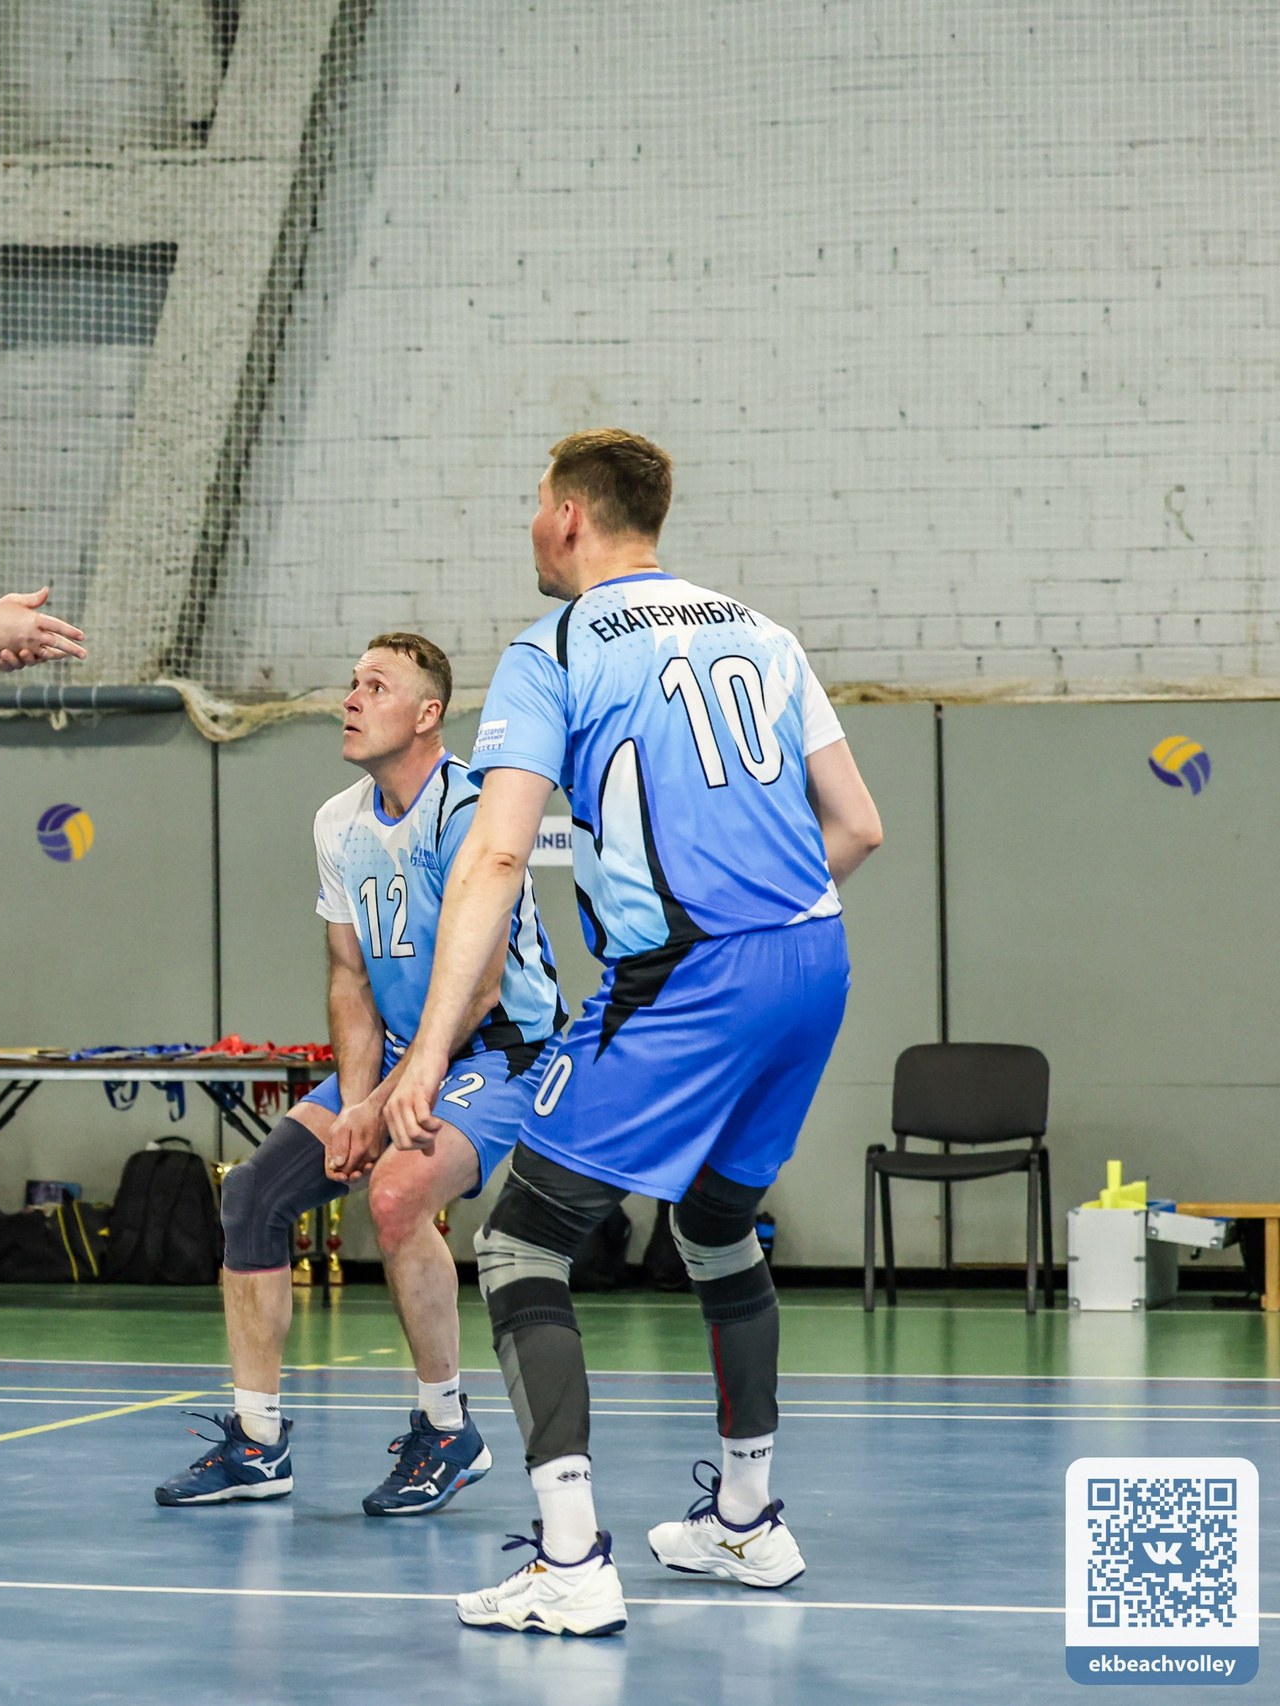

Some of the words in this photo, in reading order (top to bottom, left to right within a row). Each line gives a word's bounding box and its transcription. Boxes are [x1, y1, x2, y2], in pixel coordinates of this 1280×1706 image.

[588, 601, 758, 643] ЕКАТЕРИНБУРГ
[658, 655, 784, 789] 10
[359, 874, 416, 959] 12
[439, 1072, 486, 1110] 2
[533, 1050, 573, 1117] 0
